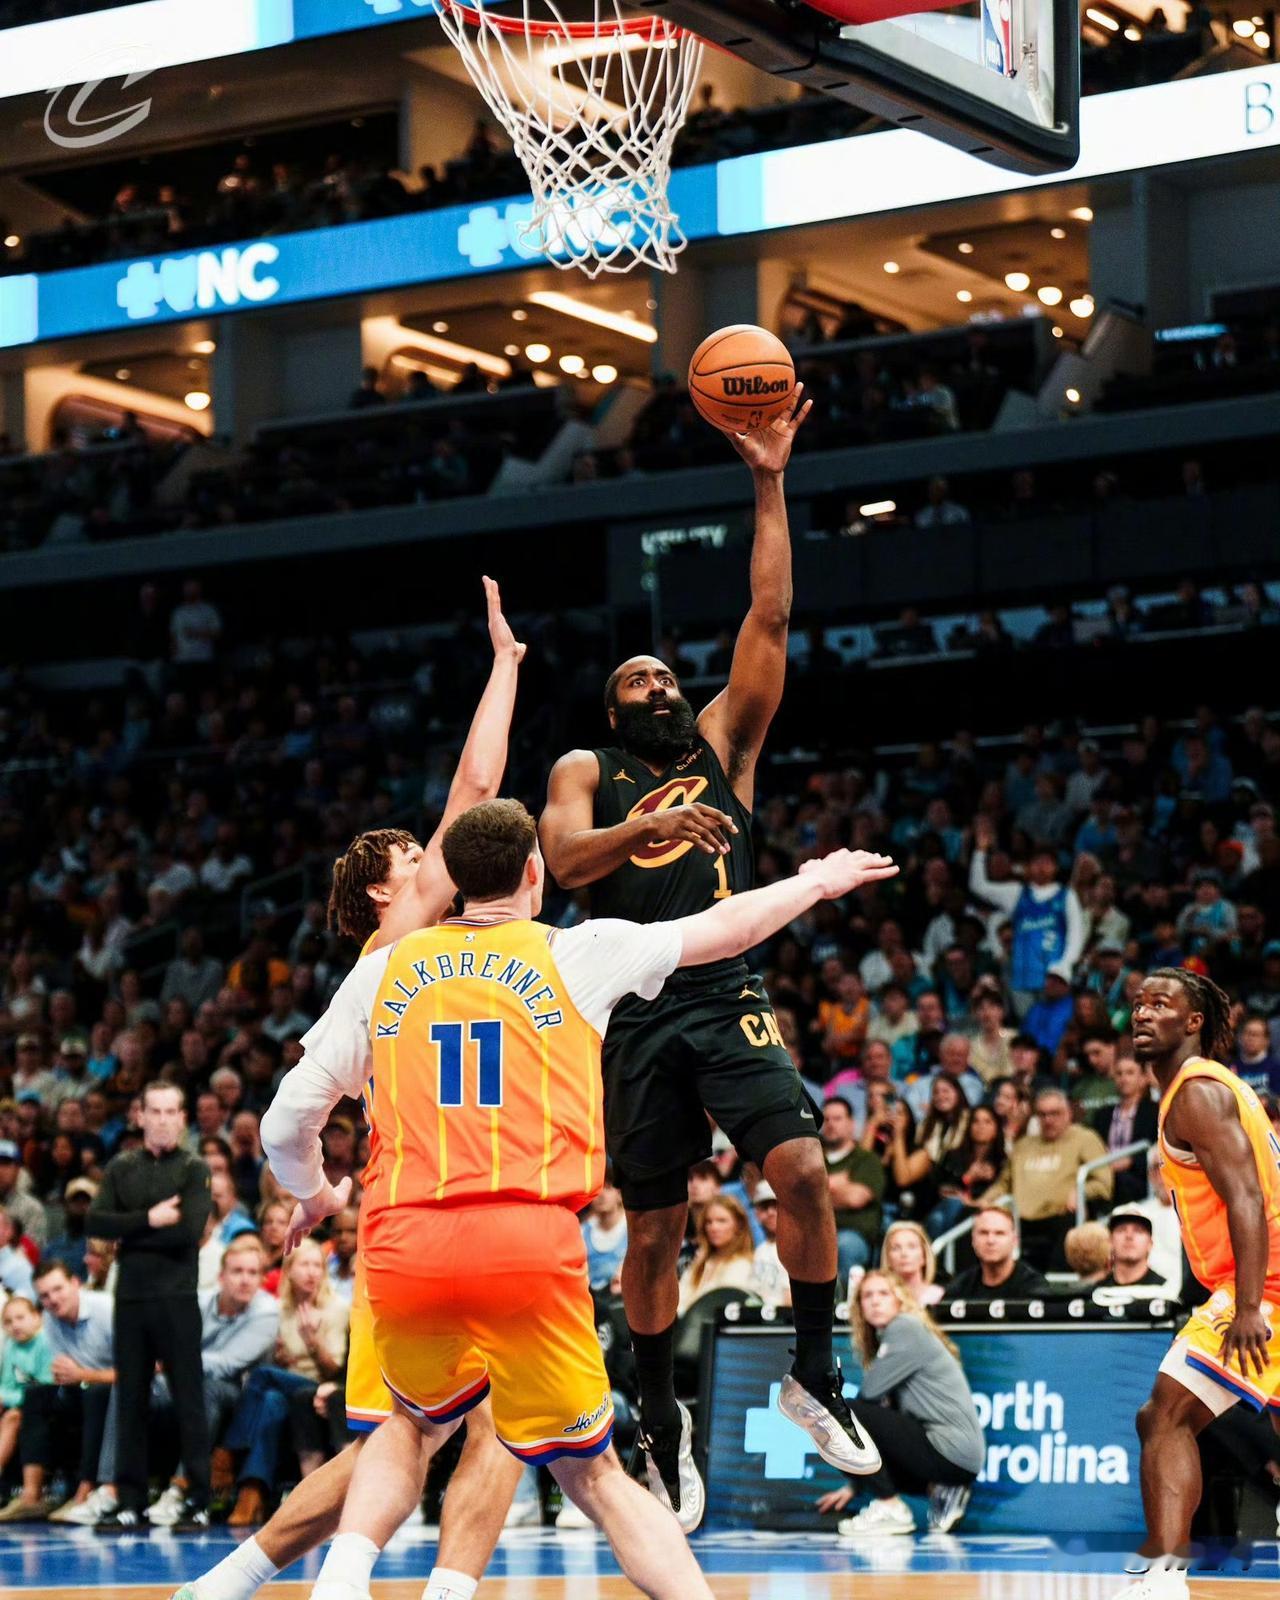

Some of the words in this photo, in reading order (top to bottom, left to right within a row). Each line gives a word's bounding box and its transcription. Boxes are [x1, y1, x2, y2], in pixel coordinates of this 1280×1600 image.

[721, 374, 789, 397] Wilson
[713, 854, 733, 899] 1
[375, 950, 565, 1039] KALKBRENNER
[428, 1018, 504, 1108] 11
[970, 1379, 1065, 1432] orth
[976, 1430, 1131, 1485] rolina
